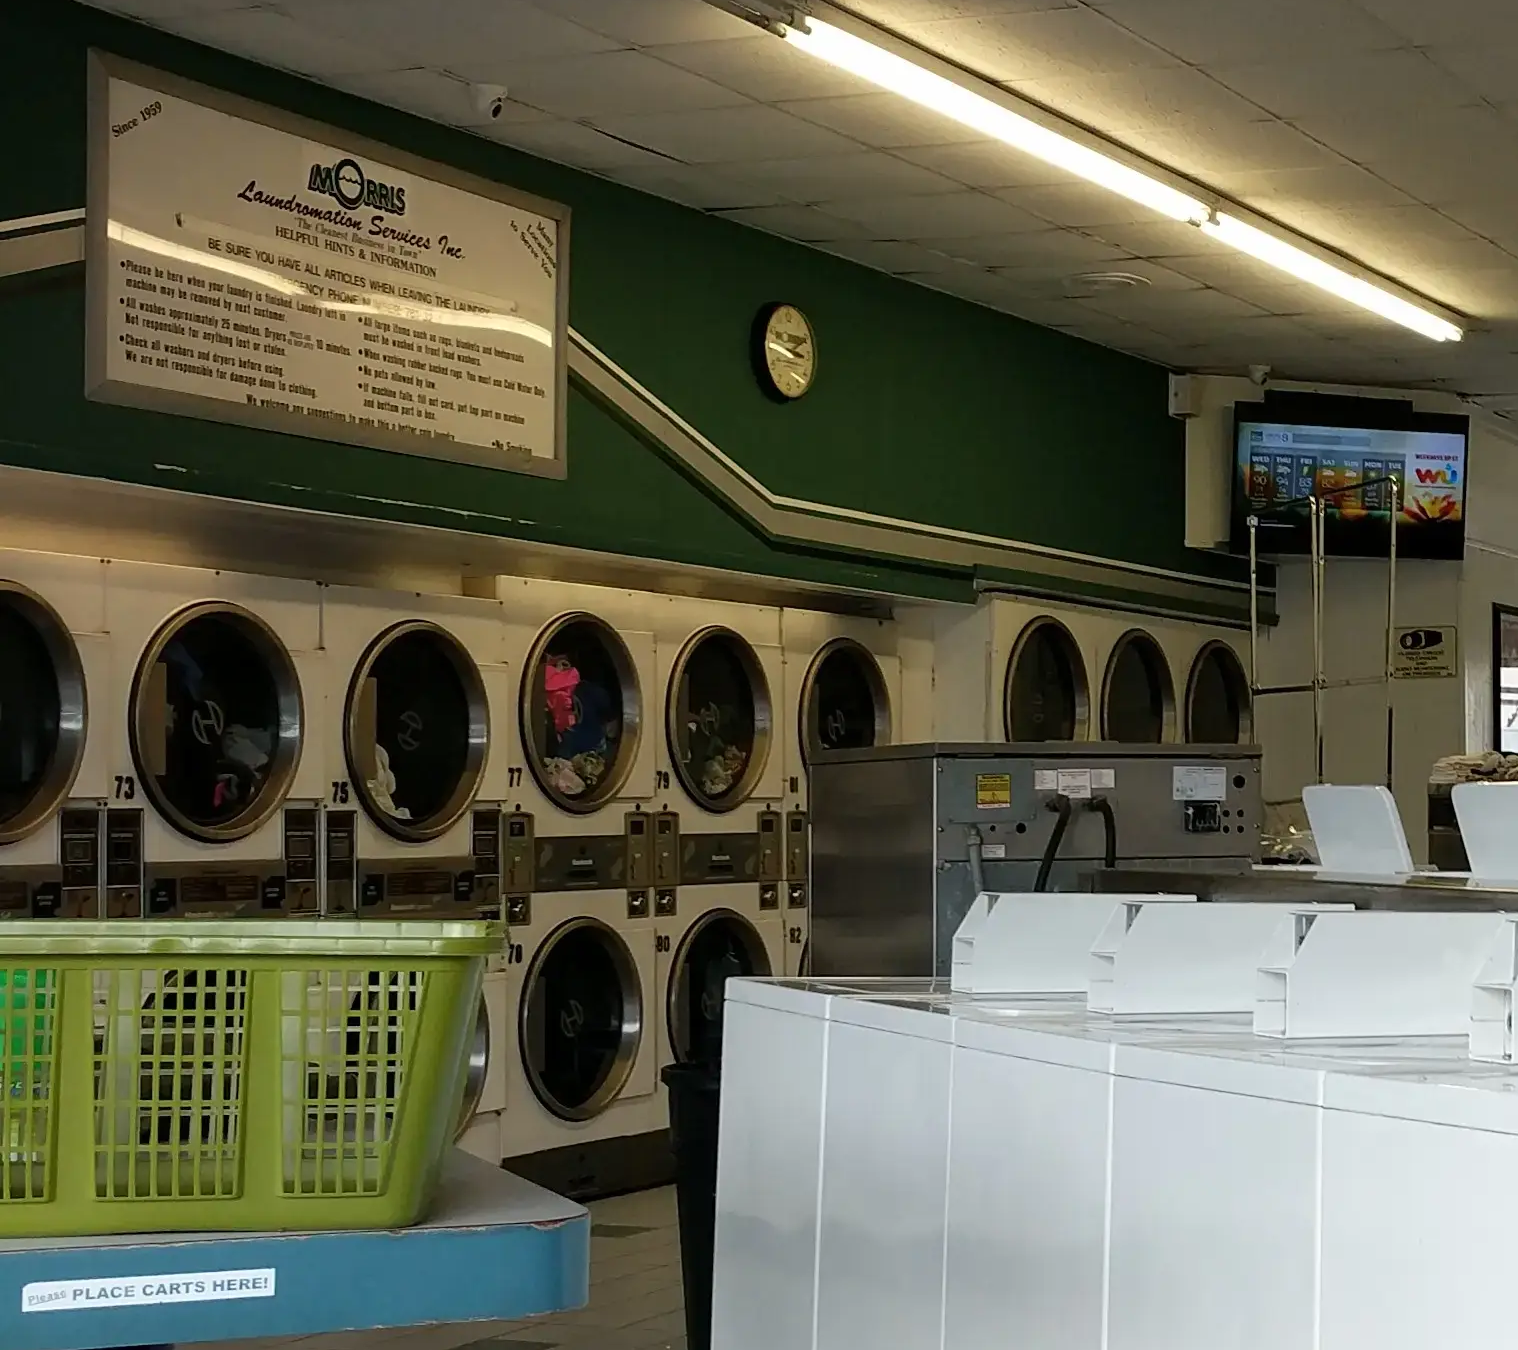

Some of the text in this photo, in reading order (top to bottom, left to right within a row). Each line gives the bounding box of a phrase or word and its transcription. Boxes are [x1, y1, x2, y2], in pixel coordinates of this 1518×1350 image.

[112, 101, 162, 137] Since 1959
[307, 158, 406, 216] MORRIS
[237, 180, 466, 259] Laundromation Services Inc.
[315, 223, 348, 241] Cleanest
[388, 242, 395, 253] in
[276, 226, 437, 278] HELPFUL HINTS & INFORMATION
[208, 237, 222, 251] BE
[225, 242, 252, 259] SURE
[255, 249, 275, 265] YOU
[278, 255, 301, 272] HAVE
[304, 263, 321, 277] ALL
[324, 267, 366, 288] ARTICLES
[369, 278, 395, 295] WHEN
[398, 287, 433, 304] LEAVING
[435, 295, 451, 309] THE
[125, 259, 152, 276] Please
[154, 266, 164, 279] be
[167, 269, 183, 283] here
[187, 276, 206, 288] when
[208, 282, 224, 292] your
[226, 284, 253, 301] laundry
[255, 291, 262, 302] is
[296, 300, 322, 318] Laundry
[126, 278, 288, 323] machine may be removed by next customer.
[327, 288, 359, 304] PHONE
[125, 312, 139, 326] Not
[142, 318, 185, 336] responsible
[188, 326, 199, 339] for
[202, 331, 233, 348] anything
[235, 336, 250, 350] lost
[252, 342, 261, 351] or
[126, 296, 136, 310] All
[139, 301, 166, 316] washes
[169, 308, 218, 328] approximately
[221, 318, 231, 330] 25
[264, 327, 287, 342] Dryers
[363, 316, 373, 327] All
[412, 329, 427, 340] such
[482, 346, 493, 355] and
[363, 332, 380, 343] must
[381, 334, 389, 346] be
[392, 339, 415, 352] washed
[125, 333, 148, 348] Check
[151, 339, 161, 351] all
[163, 343, 195, 358] washers
[197, 350, 210, 361] and
[212, 352, 236, 367] dryers
[238, 357, 262, 372] before
[363, 347, 380, 361] When
[382, 354, 406, 368] washing
[407, 359, 427, 371] rubber
[125, 349, 137, 363] We
[140, 354, 153, 366] are
[156, 357, 169, 369] not
[171, 360, 213, 378] responsible
[216, 367, 227, 380] for
[229, 371, 257, 387] damage
[259, 376, 275, 390] done
[363, 365, 372, 376] No
[374, 369, 388, 380] pets
[391, 371, 414, 385] allowed
[415, 376, 423, 388] by
[246, 393, 258, 407] We
[363, 382, 369, 393] If
[371, 386, 397, 399] machine
[503, 413, 525, 425] machine
[363, 398, 374, 409] and
[376, 400, 399, 413] bottom
[401, 406, 414, 416] part
[495, 439, 504, 450] No
[1251, 455, 1270, 463] WED
[1276, 456, 1291, 464] THU
[1300, 457, 1313, 465] FRI
[1364, 461, 1382, 469] MON
[1388, 462, 1402, 470] TUE
[1253, 475, 1267, 486] 90
[114, 775, 135, 800] 73
[508, 767, 523, 788] 77
[656, 770, 670, 790] 79
[331, 781, 349, 804] 75
[656, 935, 670, 953] 80
[789, 926, 802, 944] 82
[72, 1285, 135, 1301] PLACE
[142, 1281, 205, 1296] CARTS
[212, 1276, 268, 1292] HERE!
